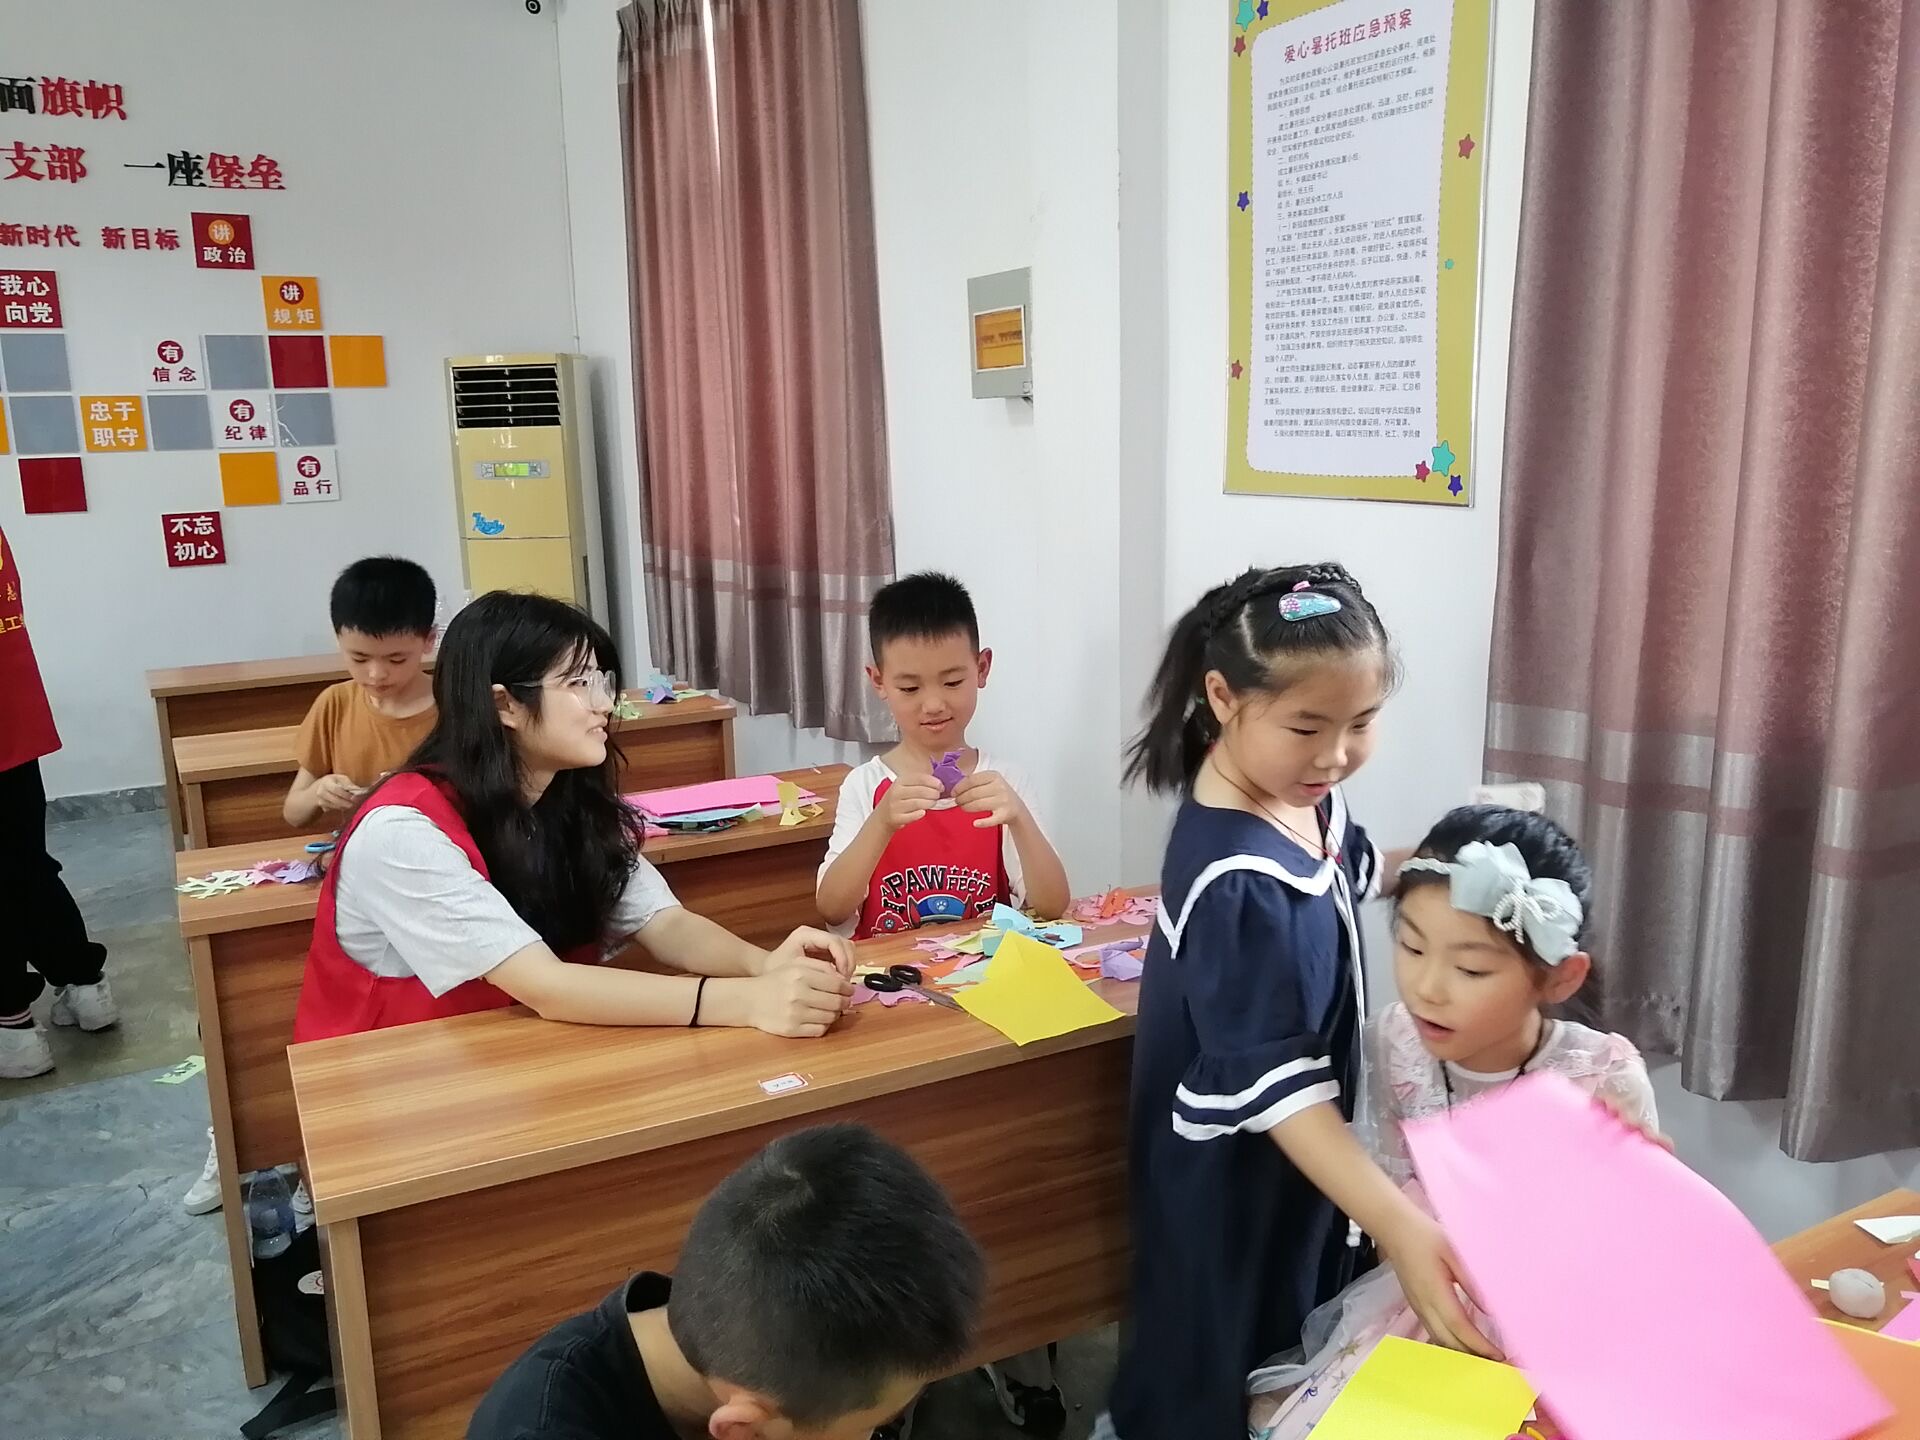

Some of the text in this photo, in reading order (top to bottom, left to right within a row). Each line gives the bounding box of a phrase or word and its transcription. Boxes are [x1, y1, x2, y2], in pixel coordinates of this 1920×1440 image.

[1284, 8, 1413, 64] 爱心暑托班应急预案
[0, 76, 127, 120] 面旗帜
[0, 141, 286, 190] 支部 一座堡垒
[0, 223, 181, 250] 新时代 新目标
[213, 224, 231, 242] 讲
[203, 246, 247, 264] 政治
[0, 275, 50, 296] 我心
[281, 284, 300, 300] 讲
[6, 302, 54, 324] 向党
[273, 308, 316, 325] 规矩
[161, 344, 180, 361] 有
[152, 367, 197, 382] 信念
[90, 401, 136, 422] 忠于
[232, 402, 252, 419] 有
[92, 427, 139, 447] 职守
[225, 425, 267, 441] 纪律
[300, 458, 318, 475] 有
[293, 479, 333, 496] 品行
[170, 516, 215, 536] 不忘
[174, 541, 218, 562] 初心
